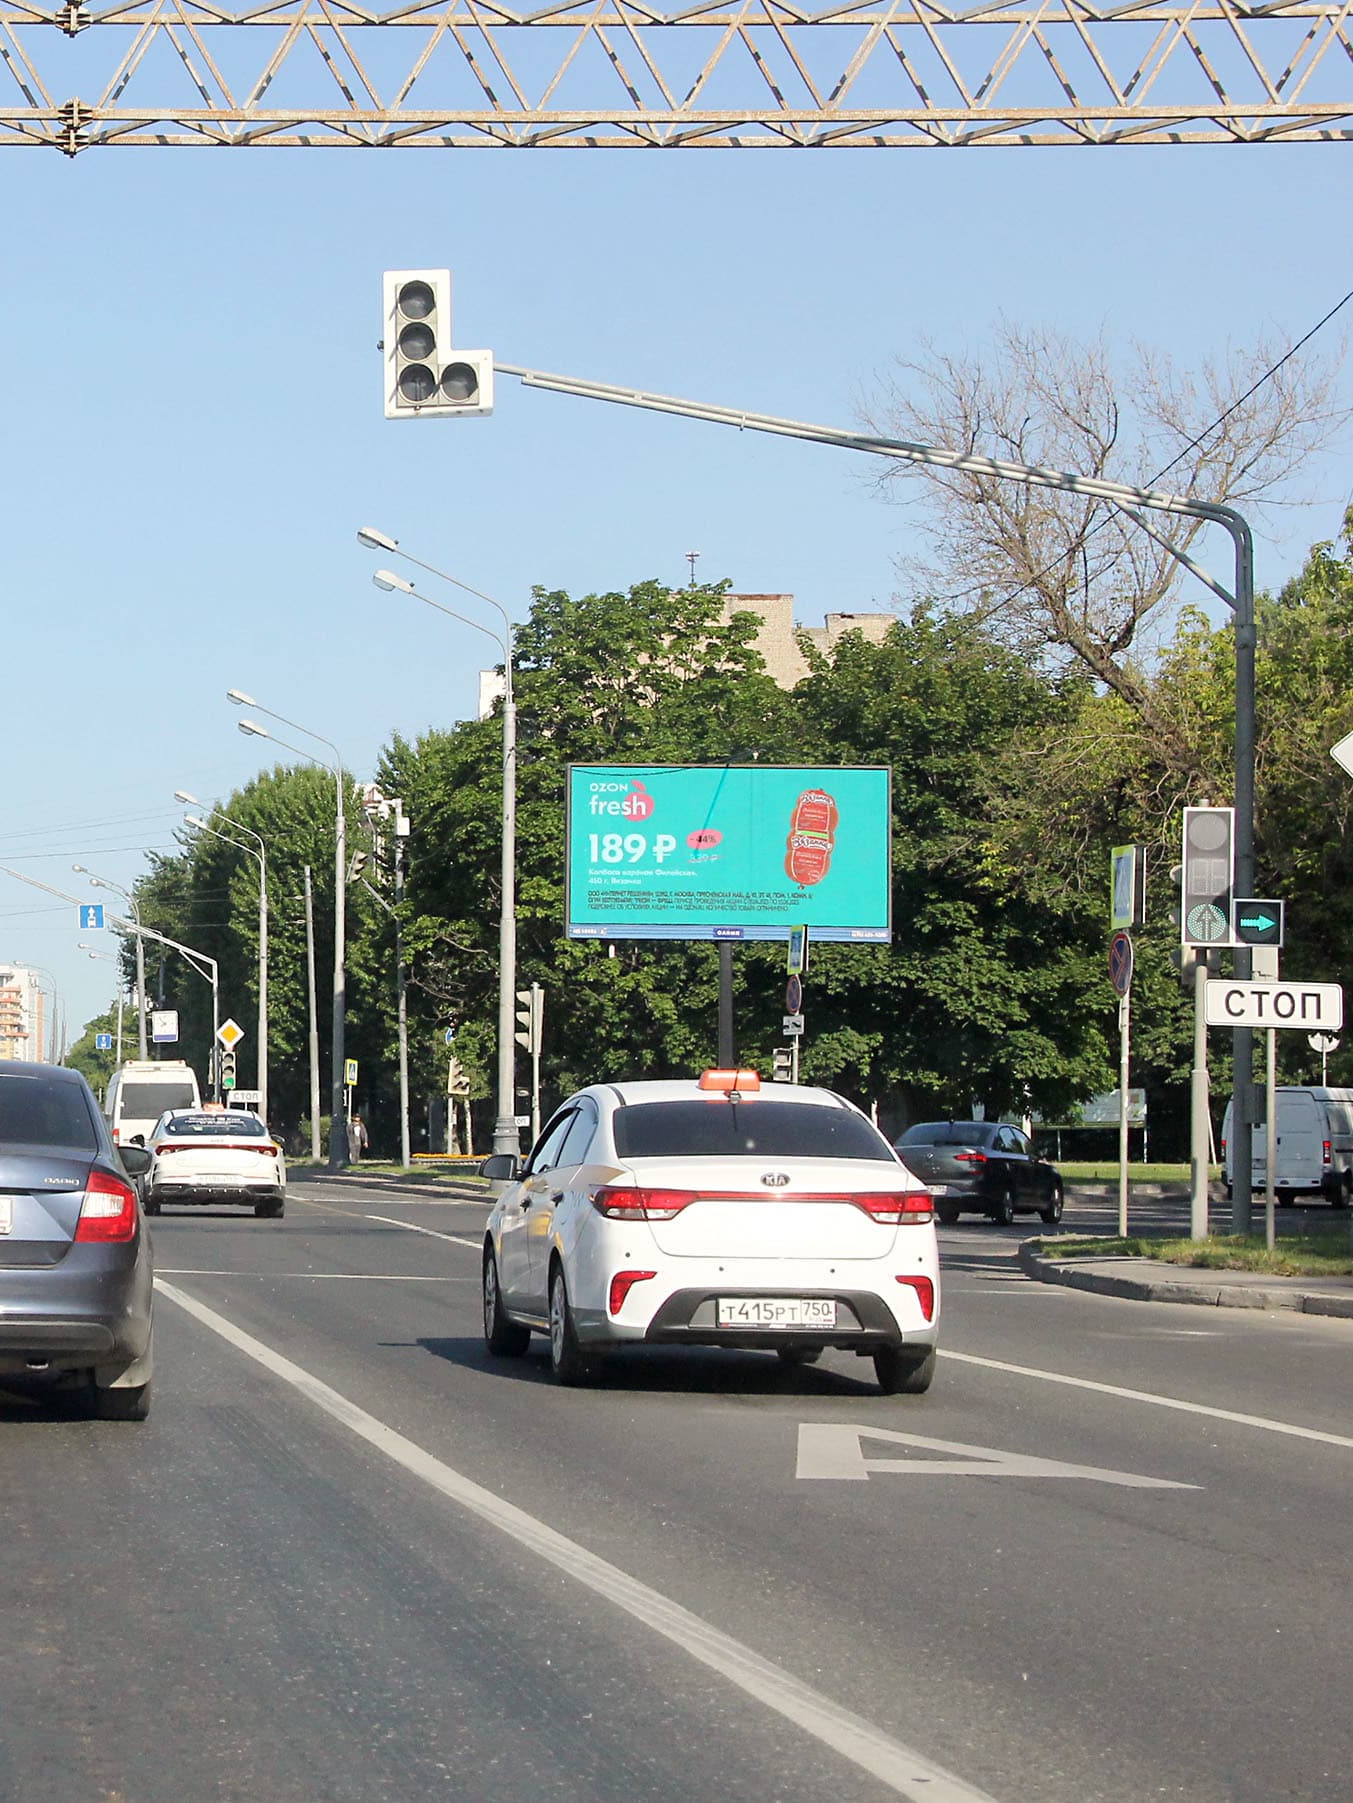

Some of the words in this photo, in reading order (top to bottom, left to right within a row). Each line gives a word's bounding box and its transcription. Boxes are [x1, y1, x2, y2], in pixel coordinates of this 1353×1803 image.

[589, 783, 628, 792] OZON
[589, 795, 646, 815] fresh
[589, 833, 647, 863] 189
[1224, 989, 1322, 1020] СТОП
[232, 1091, 260, 1100] СТОП
[765, 1174, 787, 1186] KIA
[726, 1302, 798, 1321] Т415РТ
